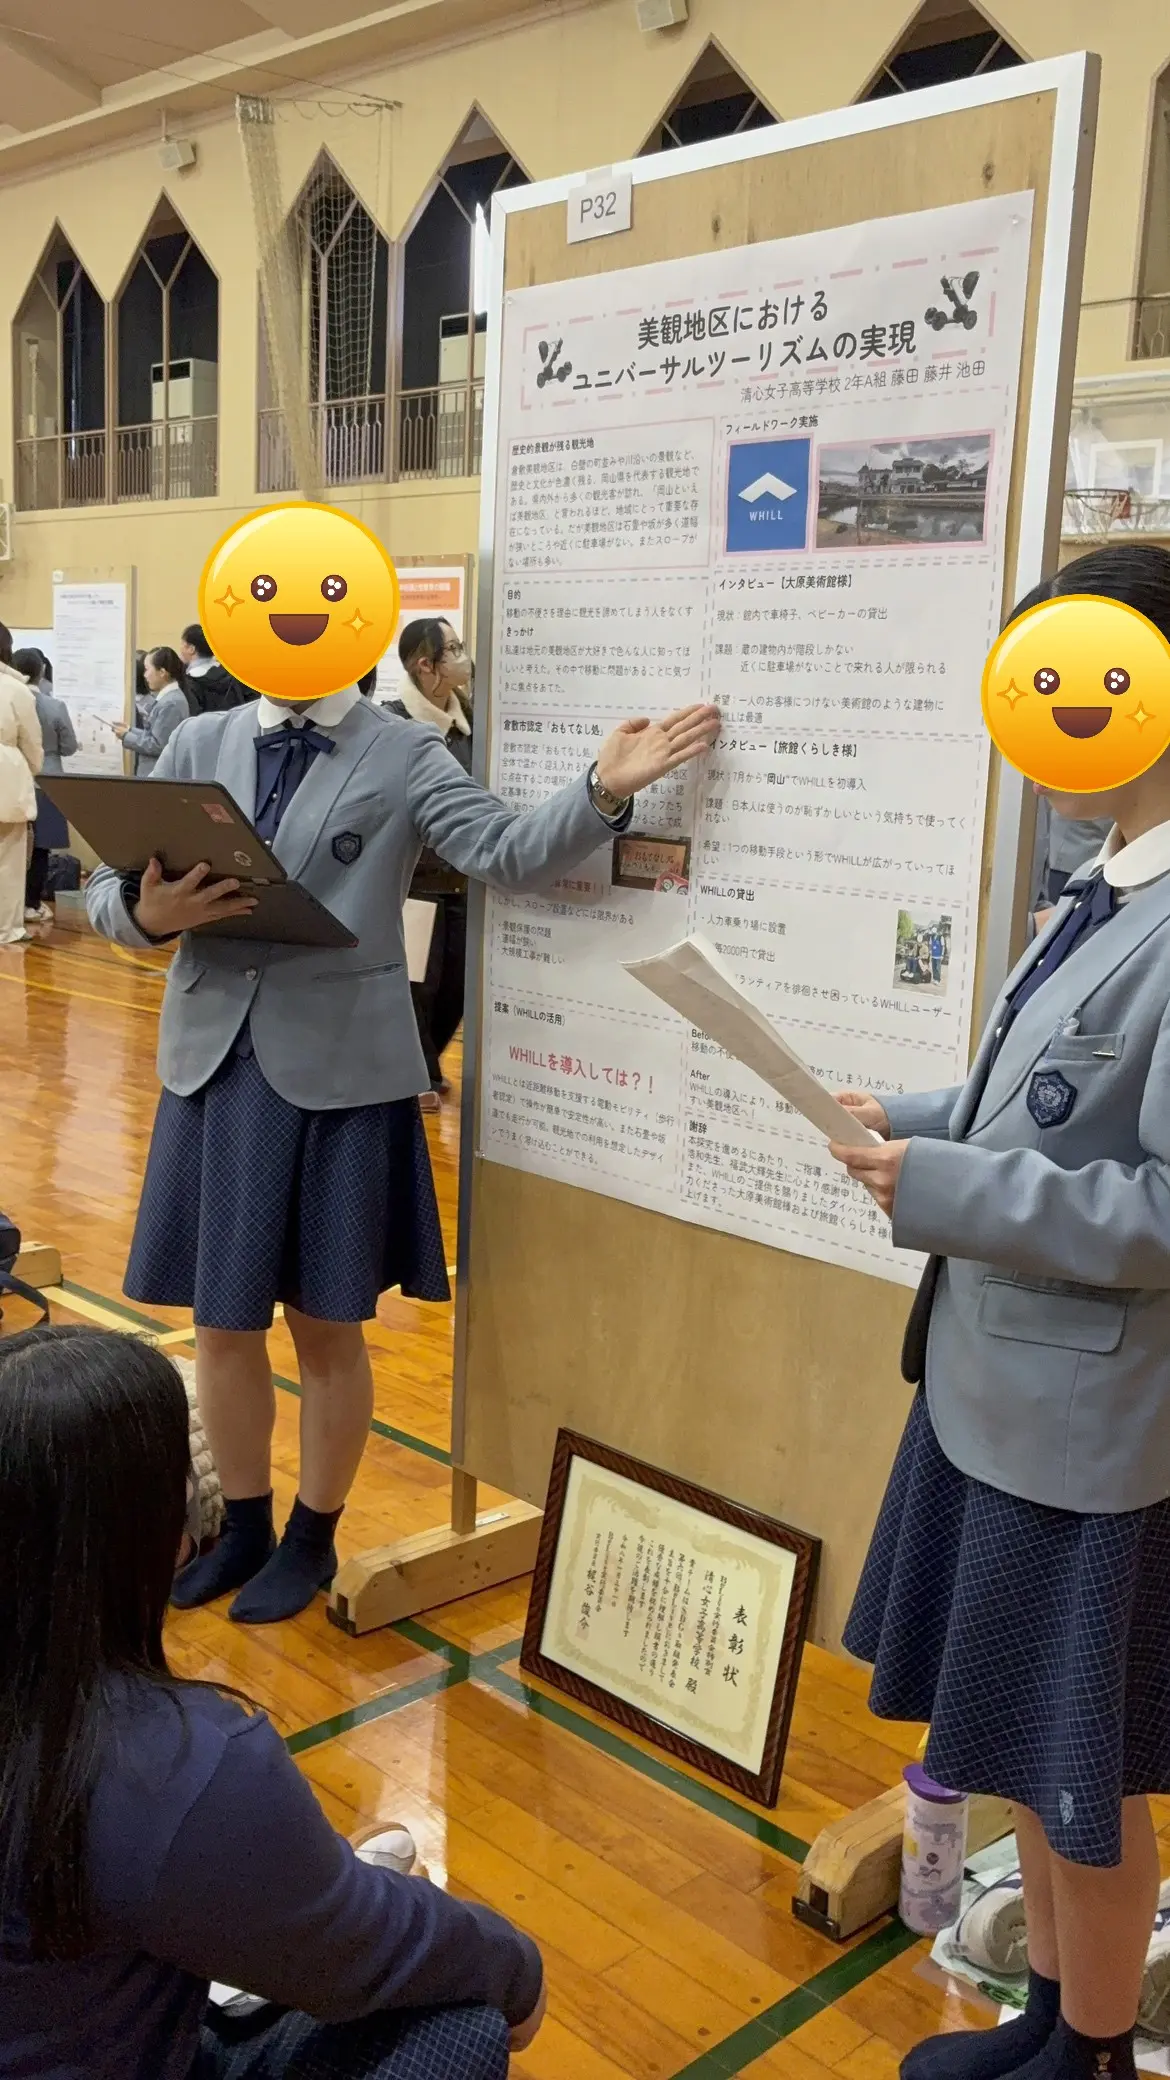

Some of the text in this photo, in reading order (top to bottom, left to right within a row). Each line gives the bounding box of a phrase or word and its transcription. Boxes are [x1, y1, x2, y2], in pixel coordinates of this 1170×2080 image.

[579, 191, 617, 223] P32
[638, 290, 828, 350] 美観地区における
[572, 320, 916, 390] ユニバーサルツーリズムの実現
[740, 359, 986, 403] 清心女子高等学校 2年A組 藤田 藤井 池田
[725, 415, 818, 435] フィールドワーク実施
[512, 437, 594, 456] 歴史的景観が残る観光地
[749, 510, 783, 521] WHILL
[719, 574, 852, 590] インタビュー【大原美術館様】
[507, 590, 521, 600] 目的
[506, 626, 534, 637] きっかけ
[740, 660, 947, 675] 近くに駐車場がないことで来れる人が限られる
[503, 719, 604, 736] 倉敷市認定「おもてなし処」
[709, 740, 858, 758] インタビュー【旅館くらしき様】
[705, 813, 730, 825] れない
[703, 855, 719, 865] しい
[700, 887, 755, 902] WHILLの貸出
[735, 973, 953, 1018] ランティアを徘徊させ困っているWHILLユーザー
[691, 1028, 713, 1041] Befo
[509, 1045, 654, 1094] WHILLを導入しては？！
[690, 1069, 711, 1081] After
[688, 1120, 708, 1135] 謝辞
[722, 1604, 748, 1688] 表彰状
[685, 1677, 698, 1695] 殿
